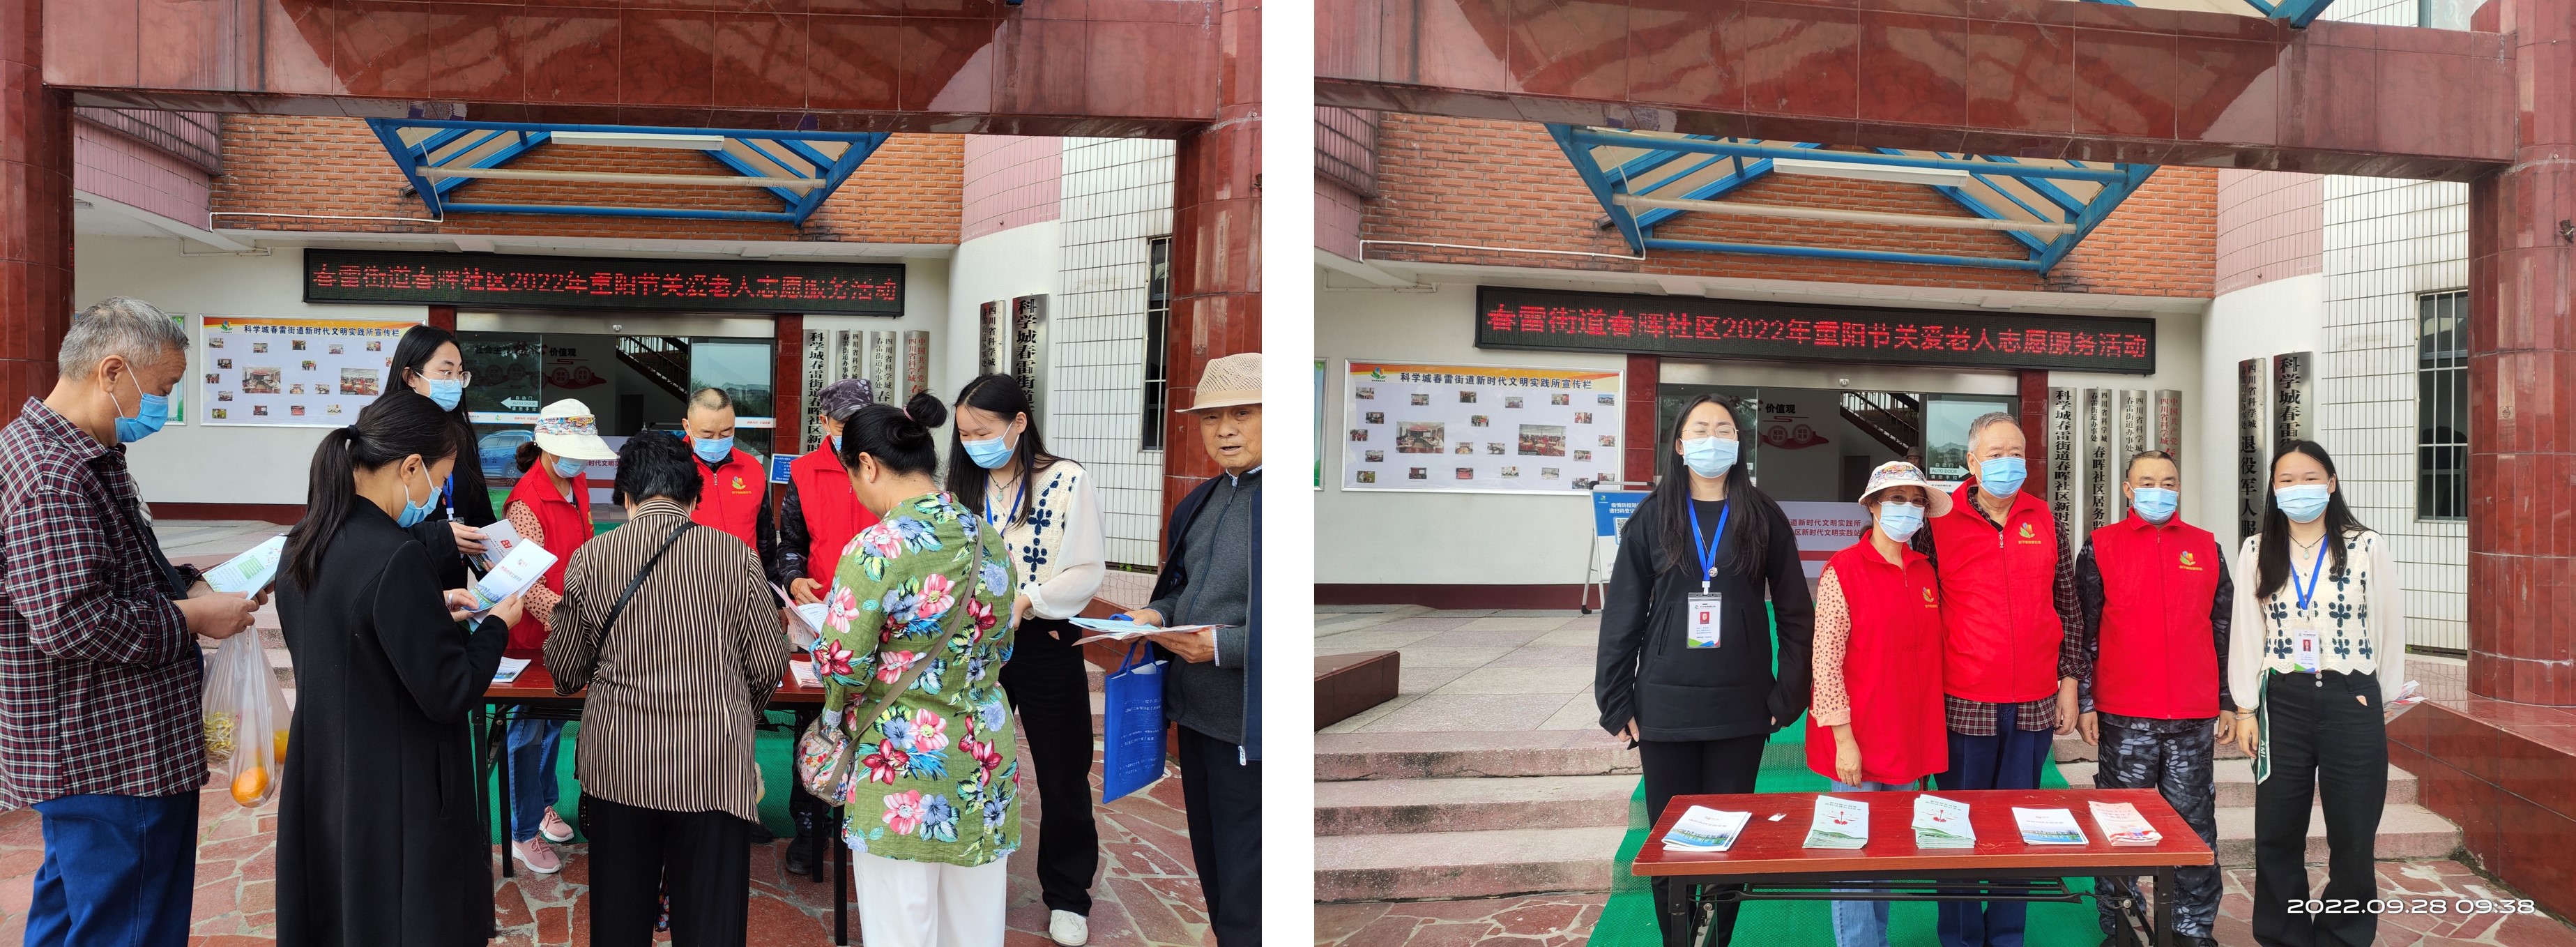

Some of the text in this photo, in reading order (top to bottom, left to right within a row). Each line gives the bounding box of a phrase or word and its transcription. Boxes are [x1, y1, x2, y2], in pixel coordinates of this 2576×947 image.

[313, 264, 897, 301] 春雷街道春晖社区2022年重阳节关爱老人志愿服务活动
[244, 324, 400, 338] 科学城春雷街道新时代文明实践所宣传栏
[988, 306, 996, 366] 四川省科学城
[1016, 298, 1037, 412] 科学城春雷街道
[1486, 304, 2147, 358] 春雷街道春晖社区2022年重阳节关爱老人志愿服务活动
[875, 338, 883, 389] 春雷街道办事处
[884, 338, 892, 389] 四川省科学城
[908, 338, 917, 382] 四川省科学城
[917, 338, 926, 382] 中国共产党
[1401, 372, 1592, 390] 科学城春雷街道新时代文明实践所宣传栏
[1765, 403, 1796, 414] 价值观
[2159, 398, 2169, 445] 四川省科学城
[2248, 364, 2257, 428] 四川省科学城
[2126, 397, 2134, 452] 春雷街道办事处
[2135, 397, 2144, 452] 四川省科学城
[2240, 435, 2257, 537] 退役军人服
[1788, 519, 1861, 527] 道新时代文明实践所
